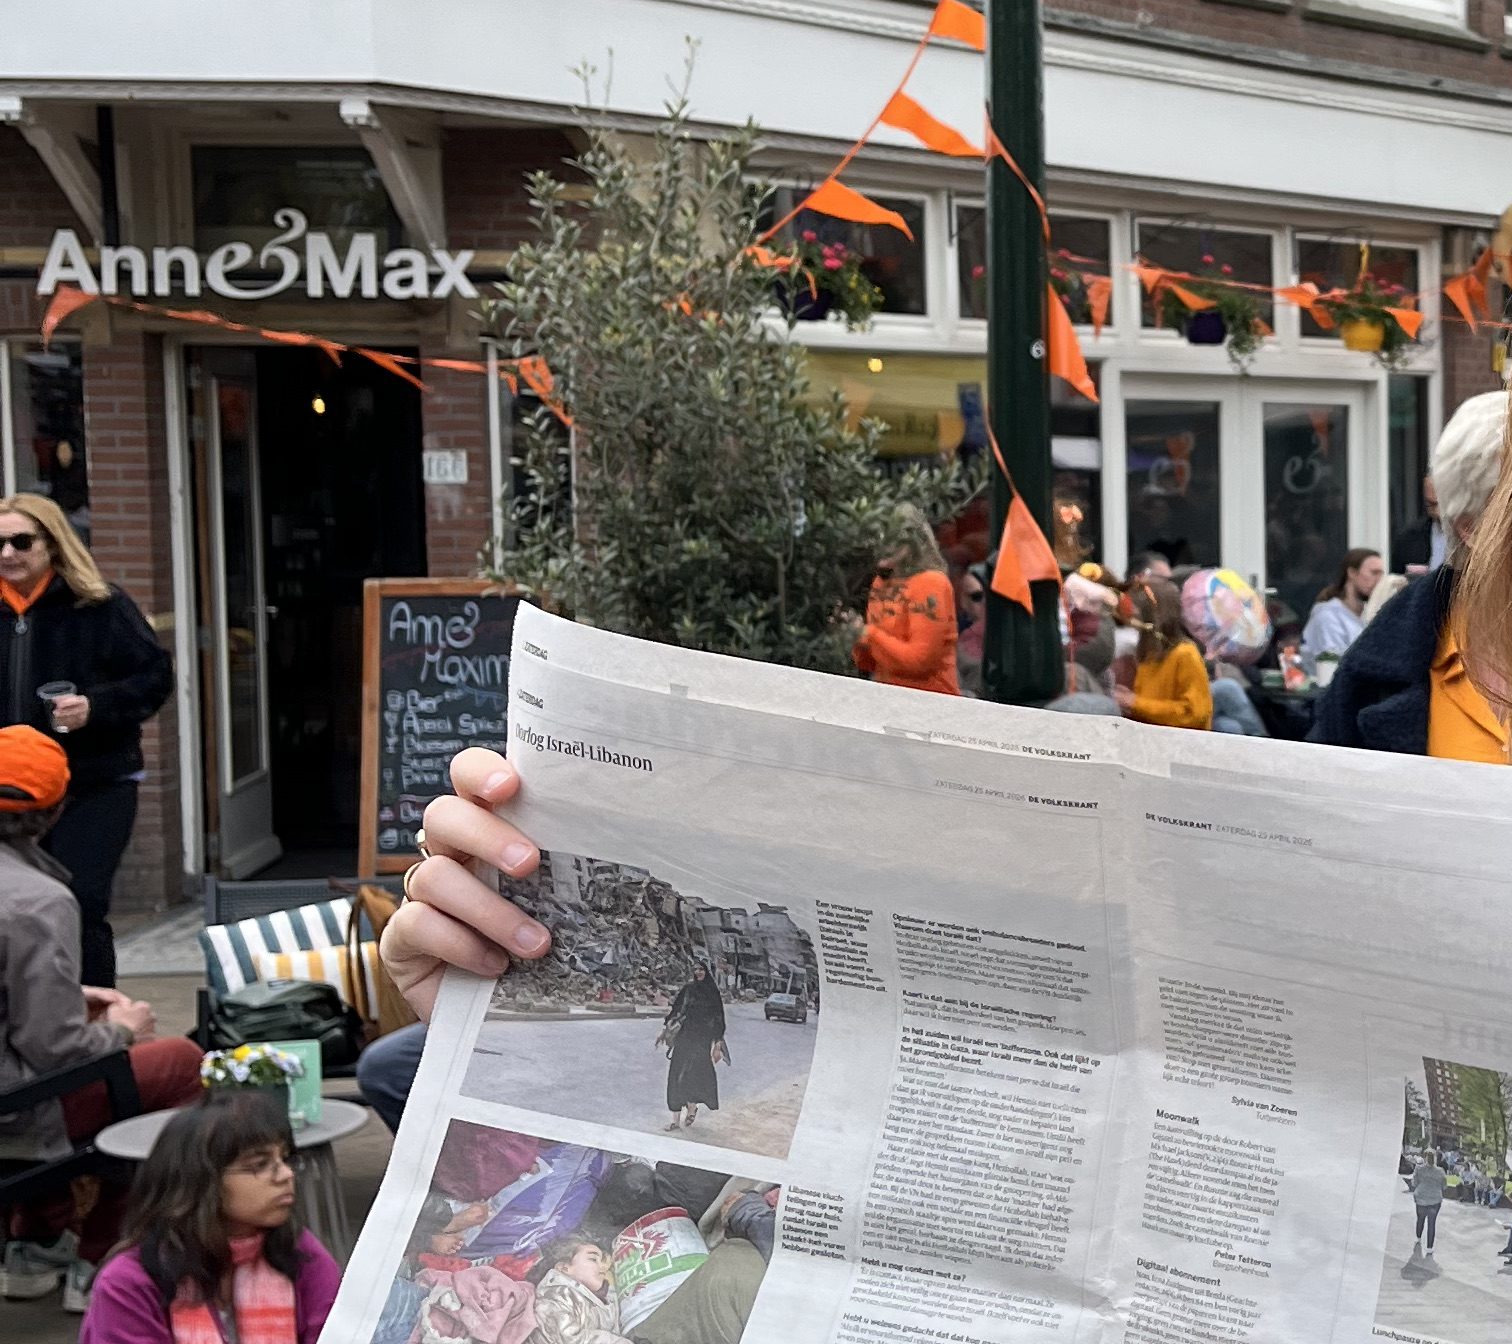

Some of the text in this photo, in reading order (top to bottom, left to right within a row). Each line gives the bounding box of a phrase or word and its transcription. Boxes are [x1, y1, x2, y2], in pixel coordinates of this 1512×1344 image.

[36, 207, 481, 300] Anne&Max
[546, 734, 653, 772] Israël-Libanon
[1034, 747, 1091, 760] VOLKSKRANT
[1040, 798, 1098, 809] VOLKSKRANT
[1157, 815, 1212, 831] VOLKSKRANT
[1136, 1256, 1221, 1287] Digitaal abonnement
